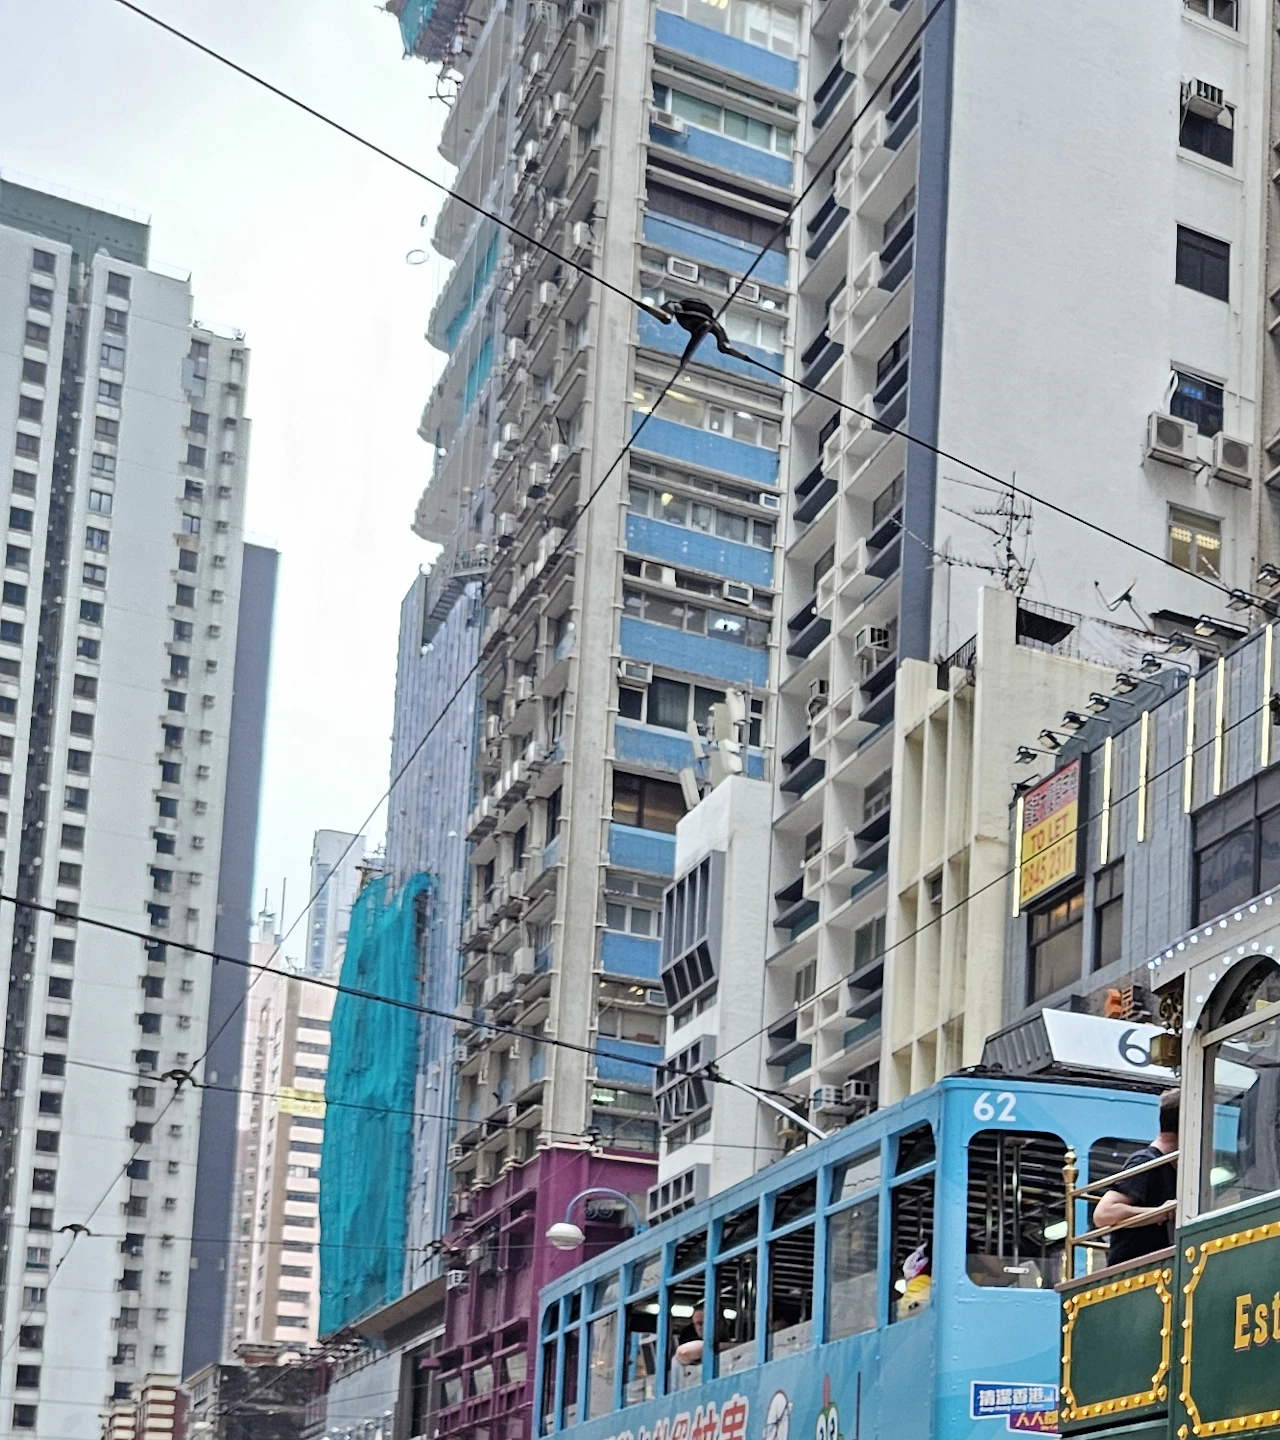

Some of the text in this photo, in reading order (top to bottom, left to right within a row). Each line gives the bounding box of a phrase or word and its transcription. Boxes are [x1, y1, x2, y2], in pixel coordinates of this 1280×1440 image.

[1030, 812, 1070, 853] TO LET
[973, 1092, 1017, 1123] 62
